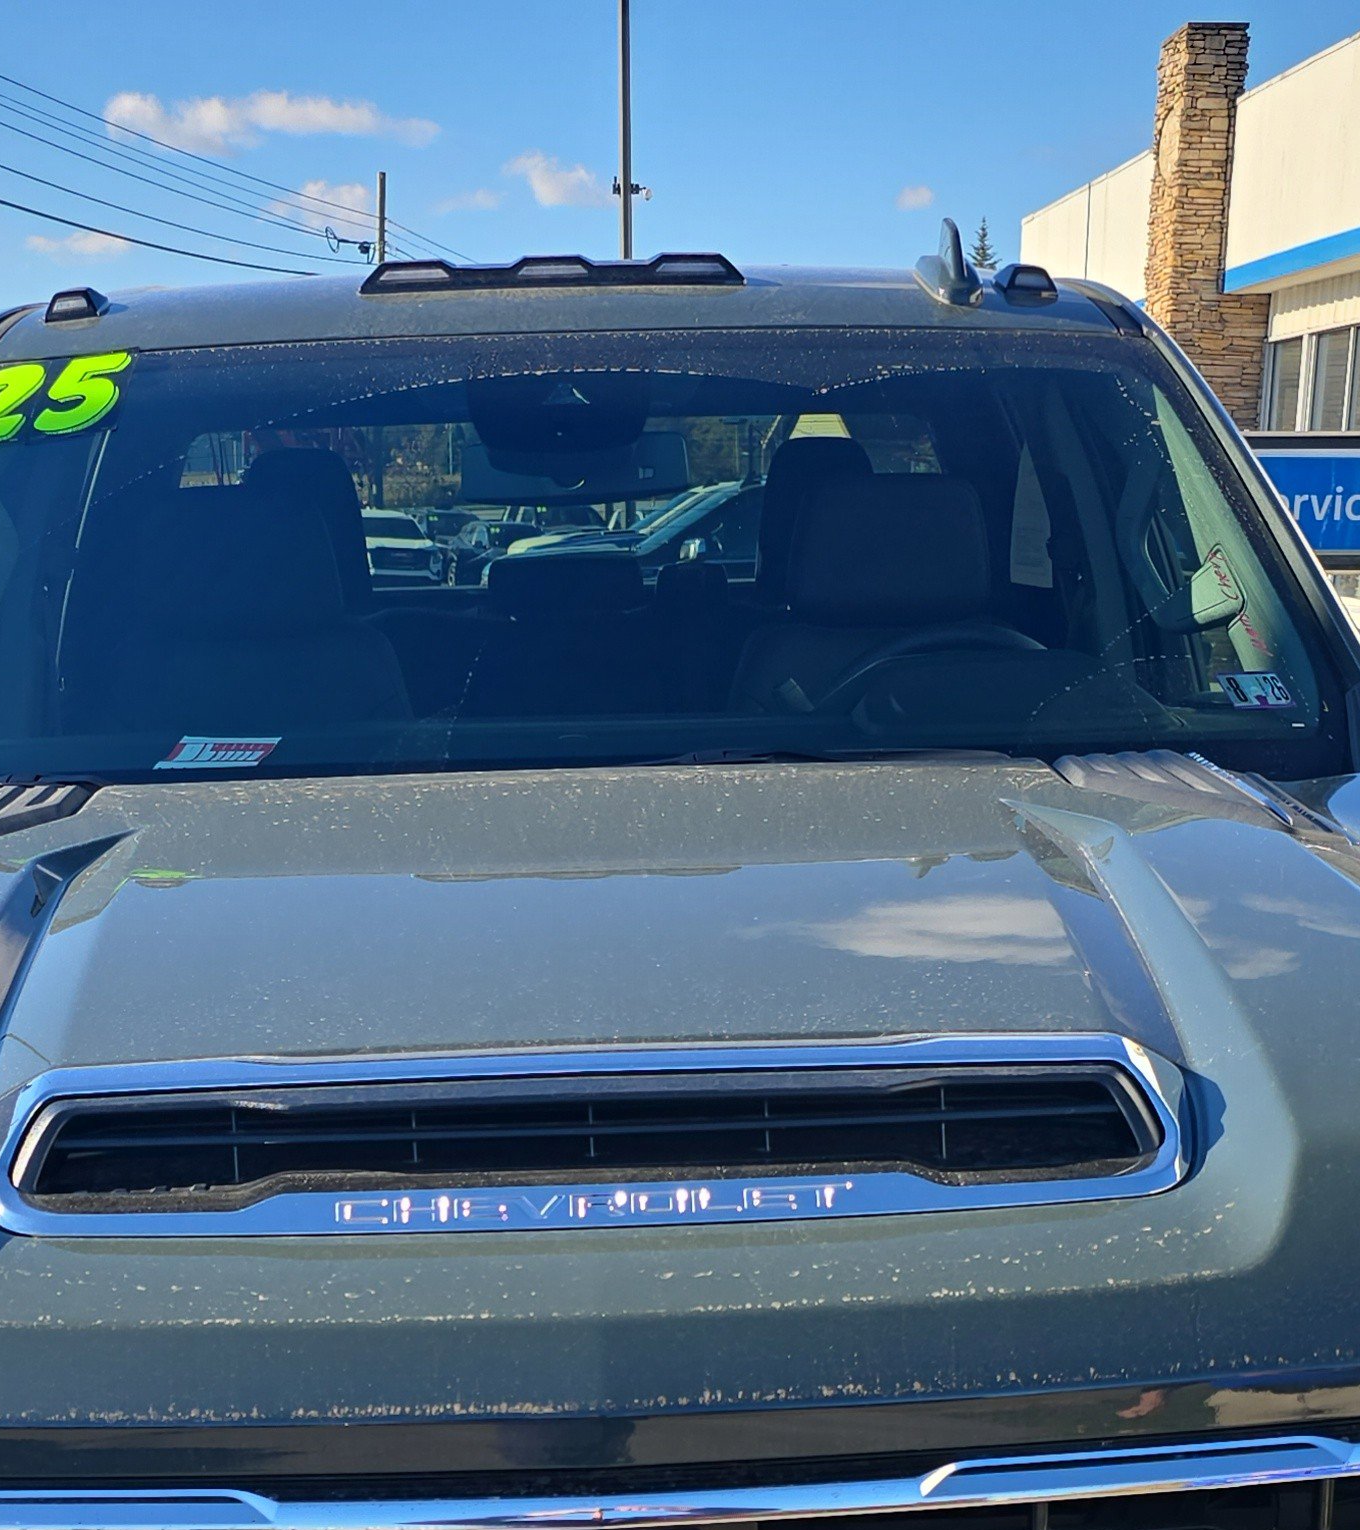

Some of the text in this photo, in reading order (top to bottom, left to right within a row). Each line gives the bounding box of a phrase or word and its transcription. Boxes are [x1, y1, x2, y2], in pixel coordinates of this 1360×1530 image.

[1226, 676, 1289, 702] 8 26
[335, 1181, 853, 1225] CHEVROLET
